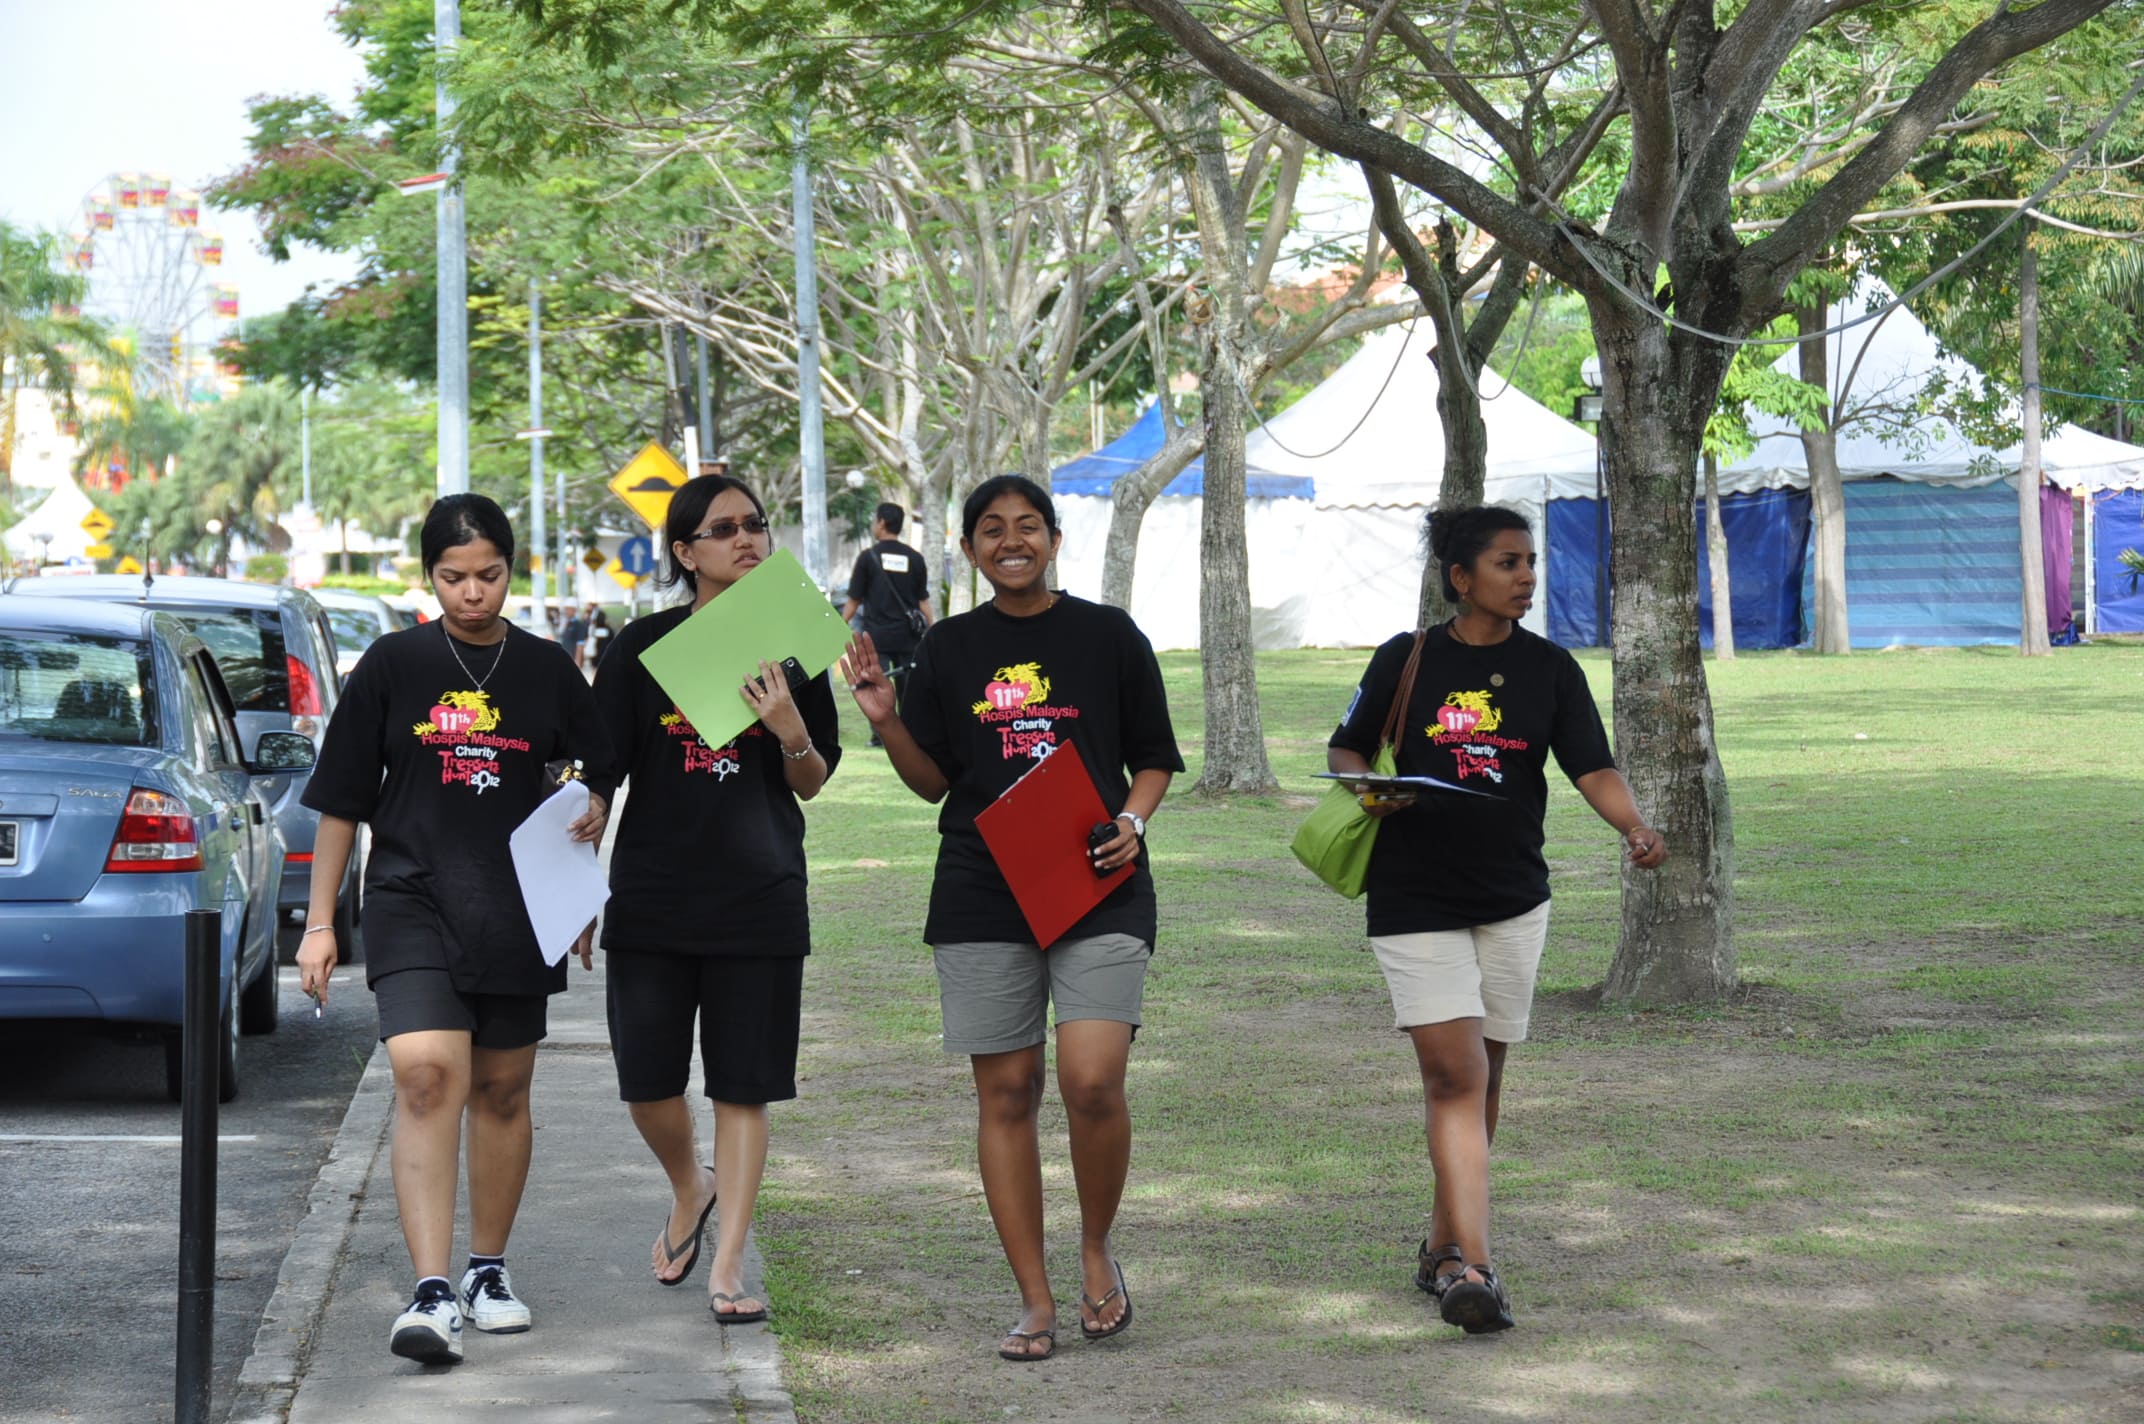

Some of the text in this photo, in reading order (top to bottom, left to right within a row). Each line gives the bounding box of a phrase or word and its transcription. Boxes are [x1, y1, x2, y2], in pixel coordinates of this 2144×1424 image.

[994, 687, 1025, 707] 11th
[439, 711, 471, 731] 11th
[980, 705, 1080, 724] Hospis Malaysia
[1446, 711, 1476, 730] 11th
[1012, 718, 1052, 731] Charity
[421, 731, 530, 752] Hospis Malaysia
[1432, 732, 1529, 751] Hospis Malaysia
[455, 745, 498, 760] Charity
[1002, 743, 1033, 760] Hunt
[441, 766, 472, 786] Hunt
